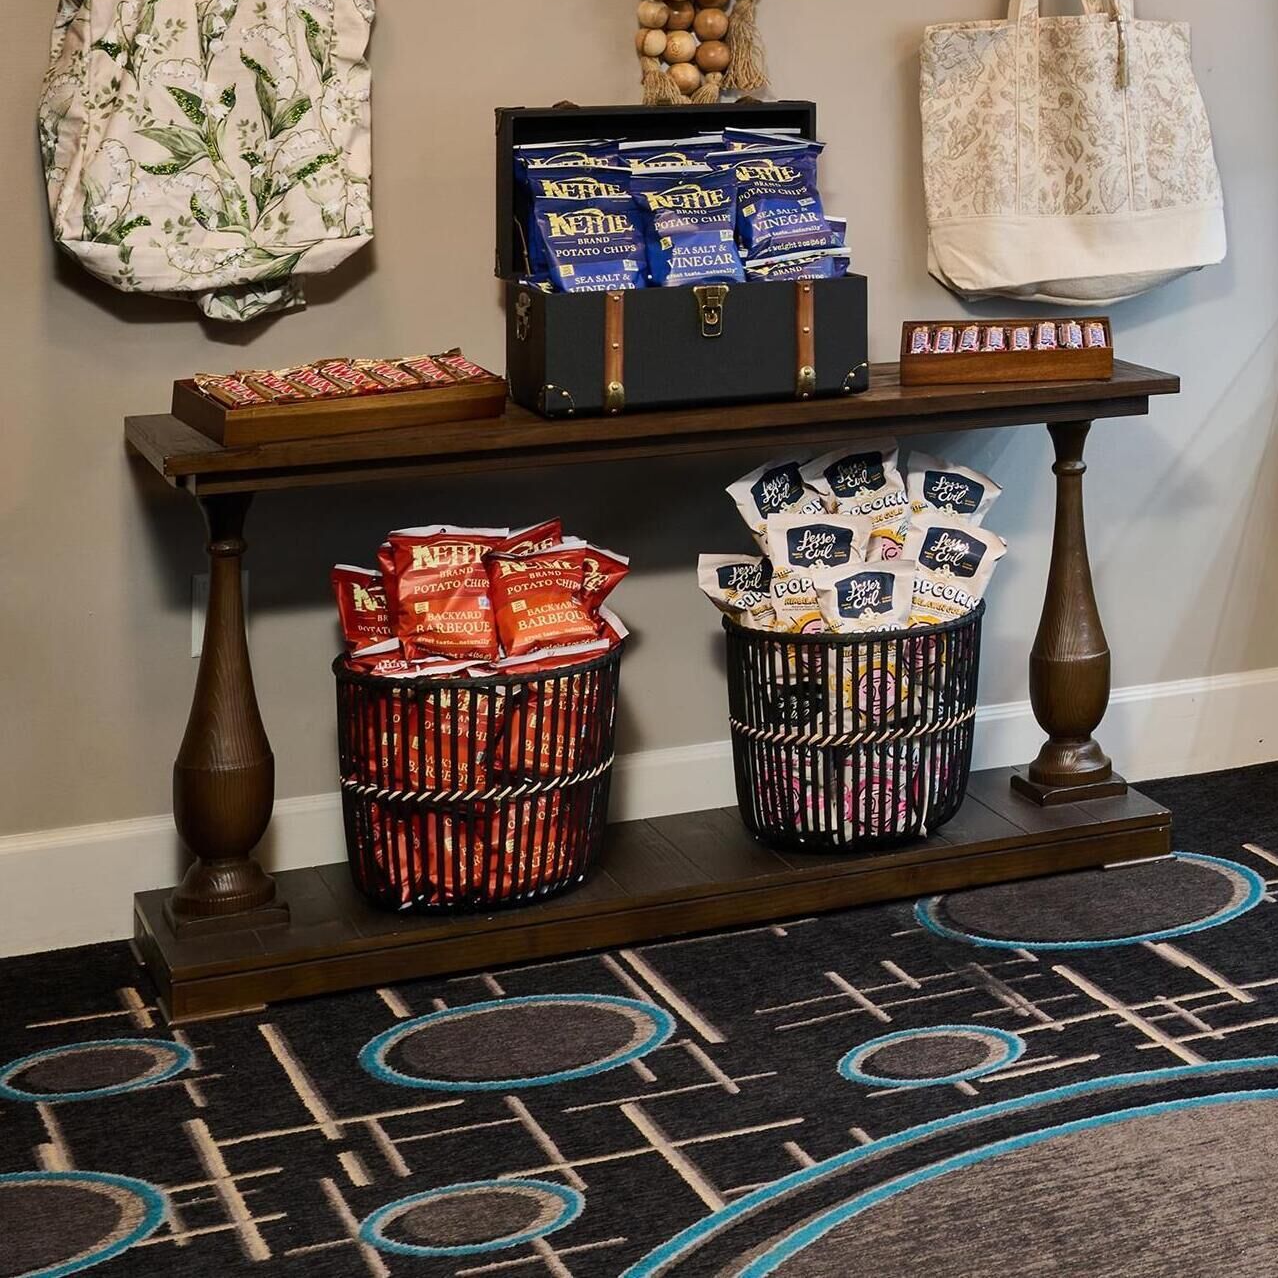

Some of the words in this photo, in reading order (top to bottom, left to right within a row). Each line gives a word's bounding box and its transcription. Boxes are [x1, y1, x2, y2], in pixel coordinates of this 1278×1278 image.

[642, 184, 732, 211] KETTLE
[738, 187, 775, 202] POTATO
[778, 186, 807, 196] CHIPS
[753, 211, 818, 232] VINEGAR
[756, 209, 776, 220] SEA
[778, 207, 799, 217] SALT
[548, 208, 634, 237] KETTLE
[655, 219, 699, 231] POTATO
[578, 236, 609, 245] BRAND
[556, 248, 600, 257] POTATO
[604, 244, 636, 254] CHIPS
[672, 246, 692, 256] SEA
[695, 245, 715, 254] SALT
[667, 253, 735, 269] VINEGAR
[773, 266, 802, 276] BRAND
[575, 276, 591, 285] SEA
[594, 274, 620, 284] SALT
[935, 477, 971, 493] Lesser
[942, 488, 965, 504] Evil
[840, 492, 909, 517] OPCORN
[797, 532, 836, 551] Lesser
[935, 534, 969, 552] Lesser
[806, 545, 833, 561] Evil
[939, 548, 963, 564] Evil
[440, 567, 474, 578] BRAND
[529, 570, 562, 579] BRAND
[413, 581, 461, 594] POTATO
[464, 577, 490, 589] CHIPS
[507, 581, 553, 595] POTATO
[848, 579, 881, 597] Lesser
[855, 593, 879, 608] Evil
[427, 610, 482, 621] BACKYARD
[417, 621, 491, 633] BARBEQUE
